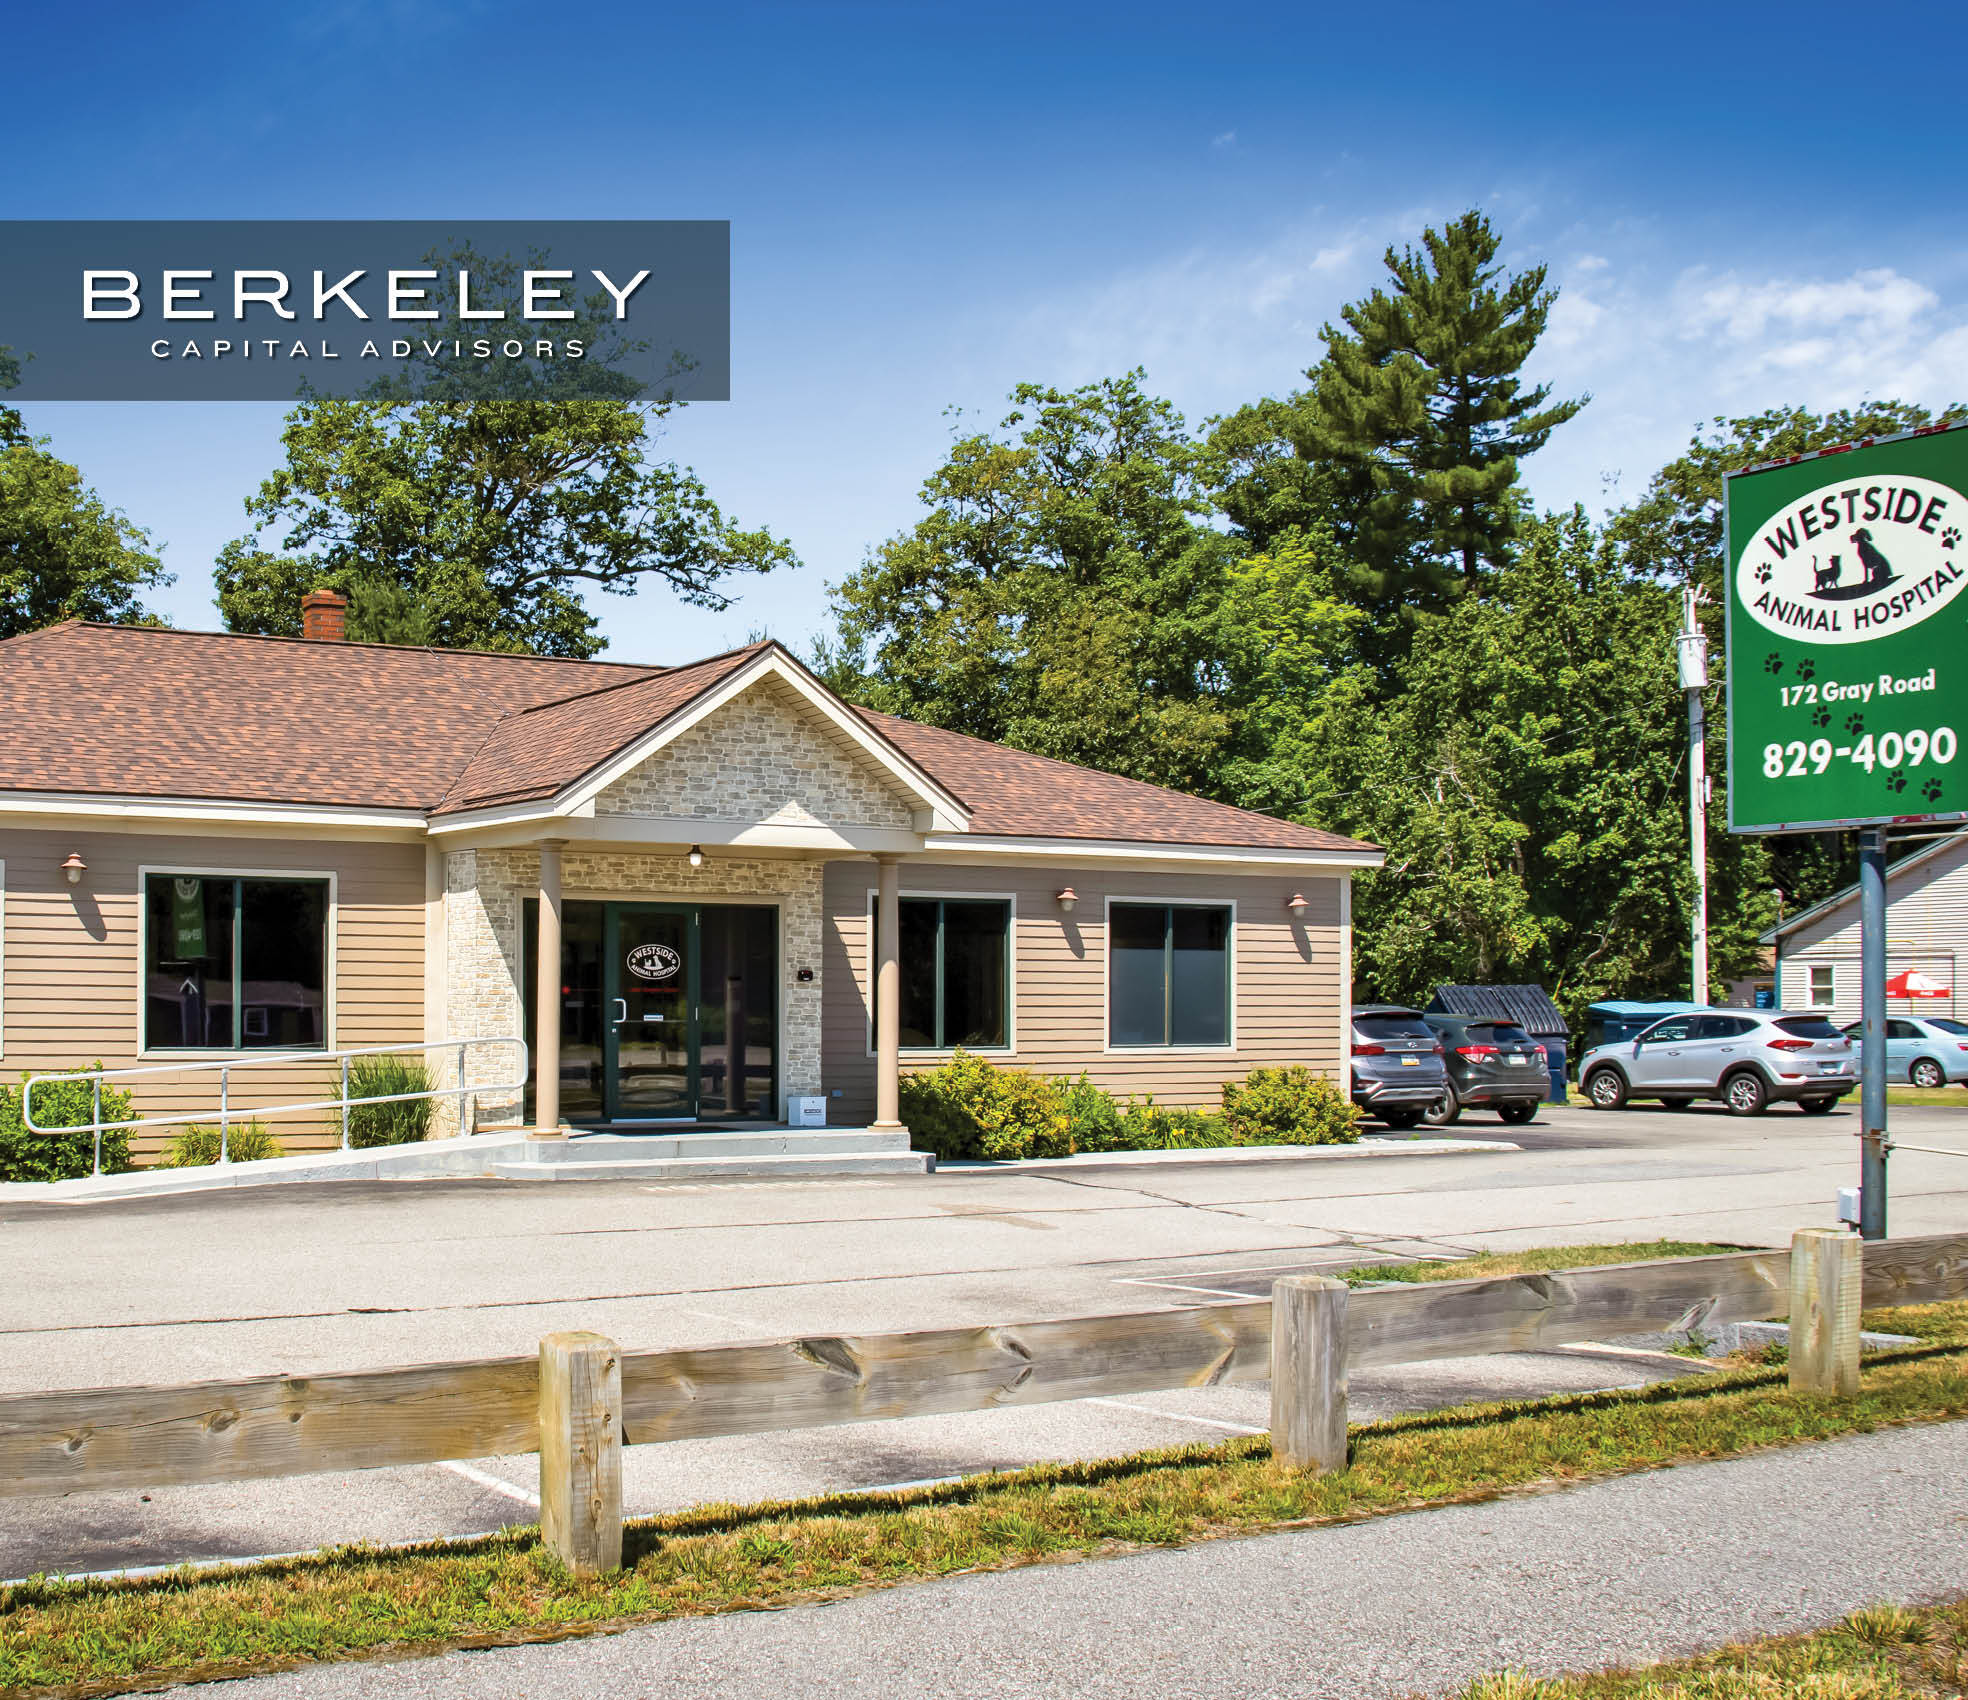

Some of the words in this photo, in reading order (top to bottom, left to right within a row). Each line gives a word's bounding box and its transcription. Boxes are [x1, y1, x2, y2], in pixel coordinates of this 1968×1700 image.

[1764, 487, 1947, 560] WESTSIDE
[1754, 591, 1841, 632] ANIMAL
[1854, 561, 1964, 630] HOSPITAL
[1780, 685, 1818, 707] 172
[1822, 681, 1874, 703] Gray
[1878, 668, 1936, 696] Road
[1763, 726, 1957, 779] 829-4090
[631, 964, 651, 976] ANIMAL
[653, 965, 677, 976] HOSPITAL
[633, 947, 674, 960] WESTSIDE
